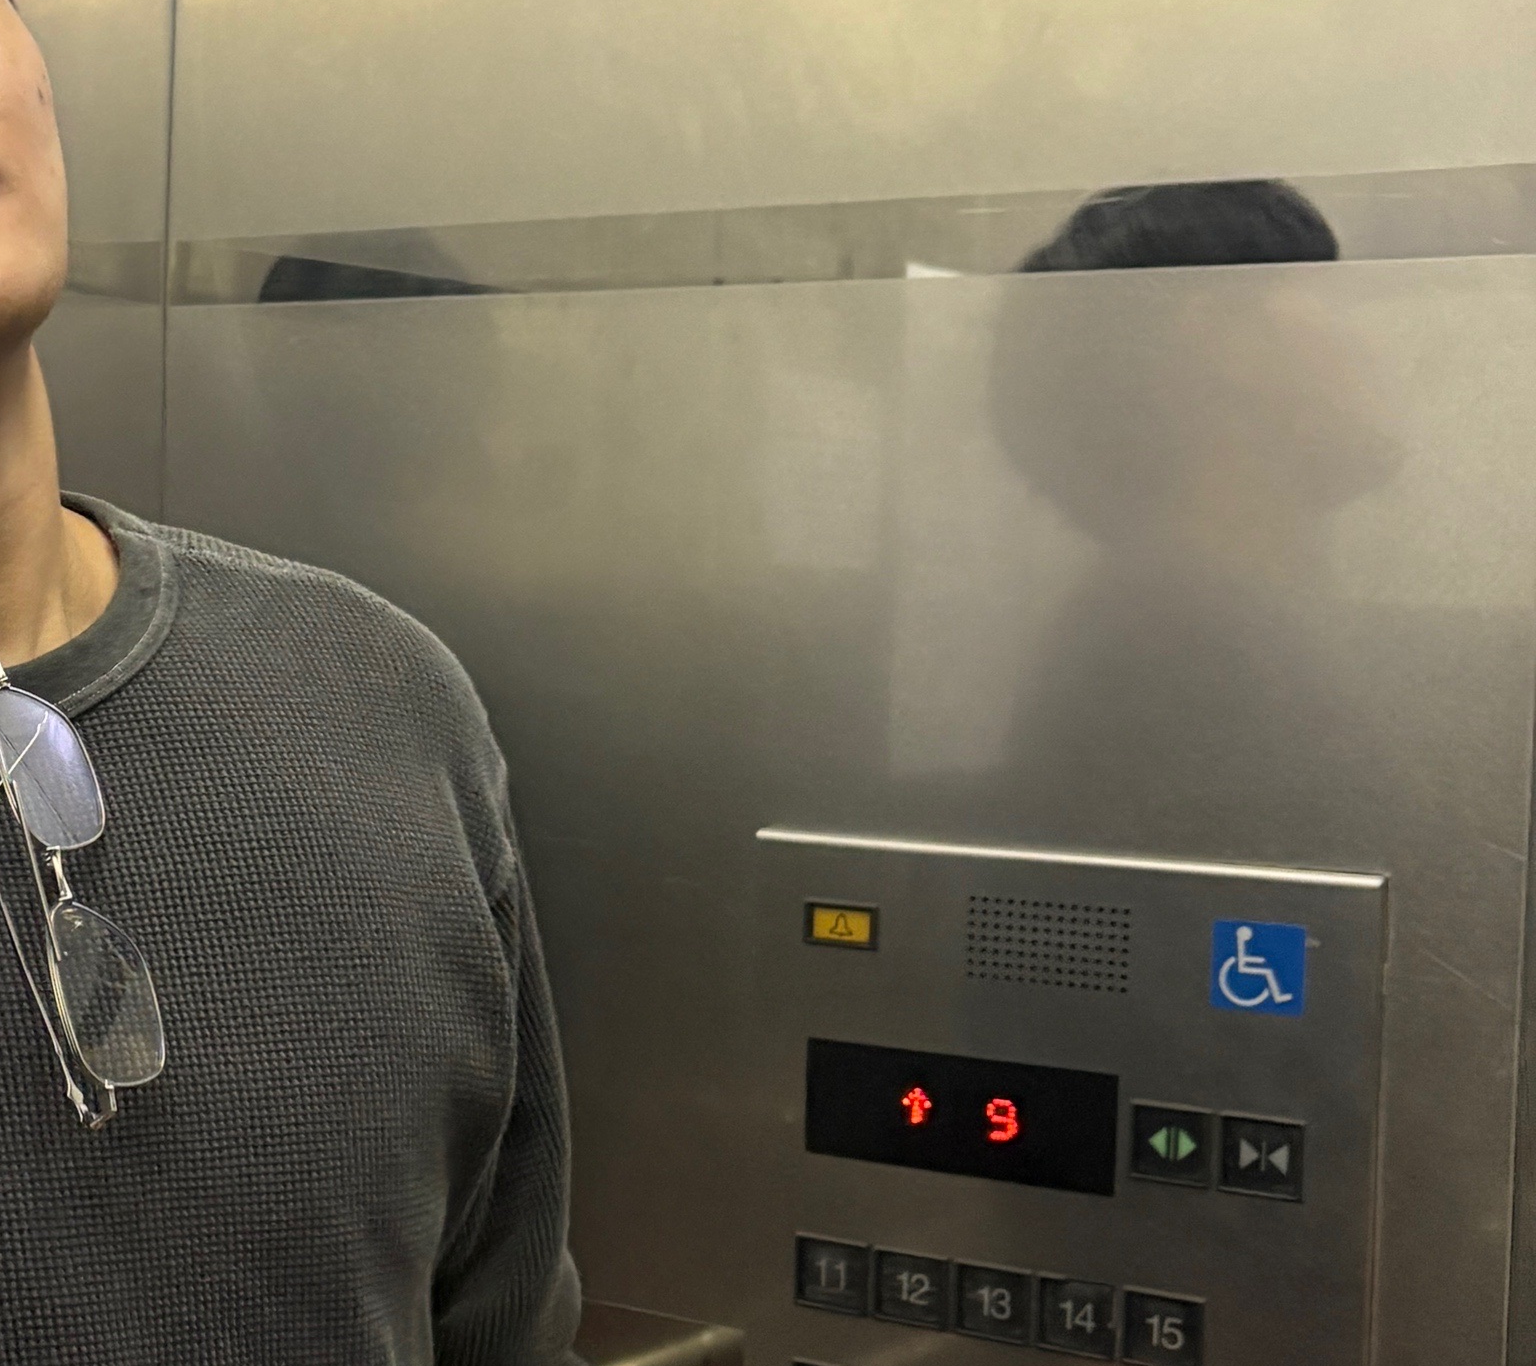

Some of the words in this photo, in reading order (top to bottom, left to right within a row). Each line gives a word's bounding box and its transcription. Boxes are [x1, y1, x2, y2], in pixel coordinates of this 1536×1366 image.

[984, 1097, 1019, 1144] 9
[815, 1257, 846, 1292] 11
[897, 1273, 931, 1307] 12
[977, 1287, 1011, 1320] 13
[1058, 1300, 1096, 1334] 14
[1146, 1315, 1184, 1351] 15
